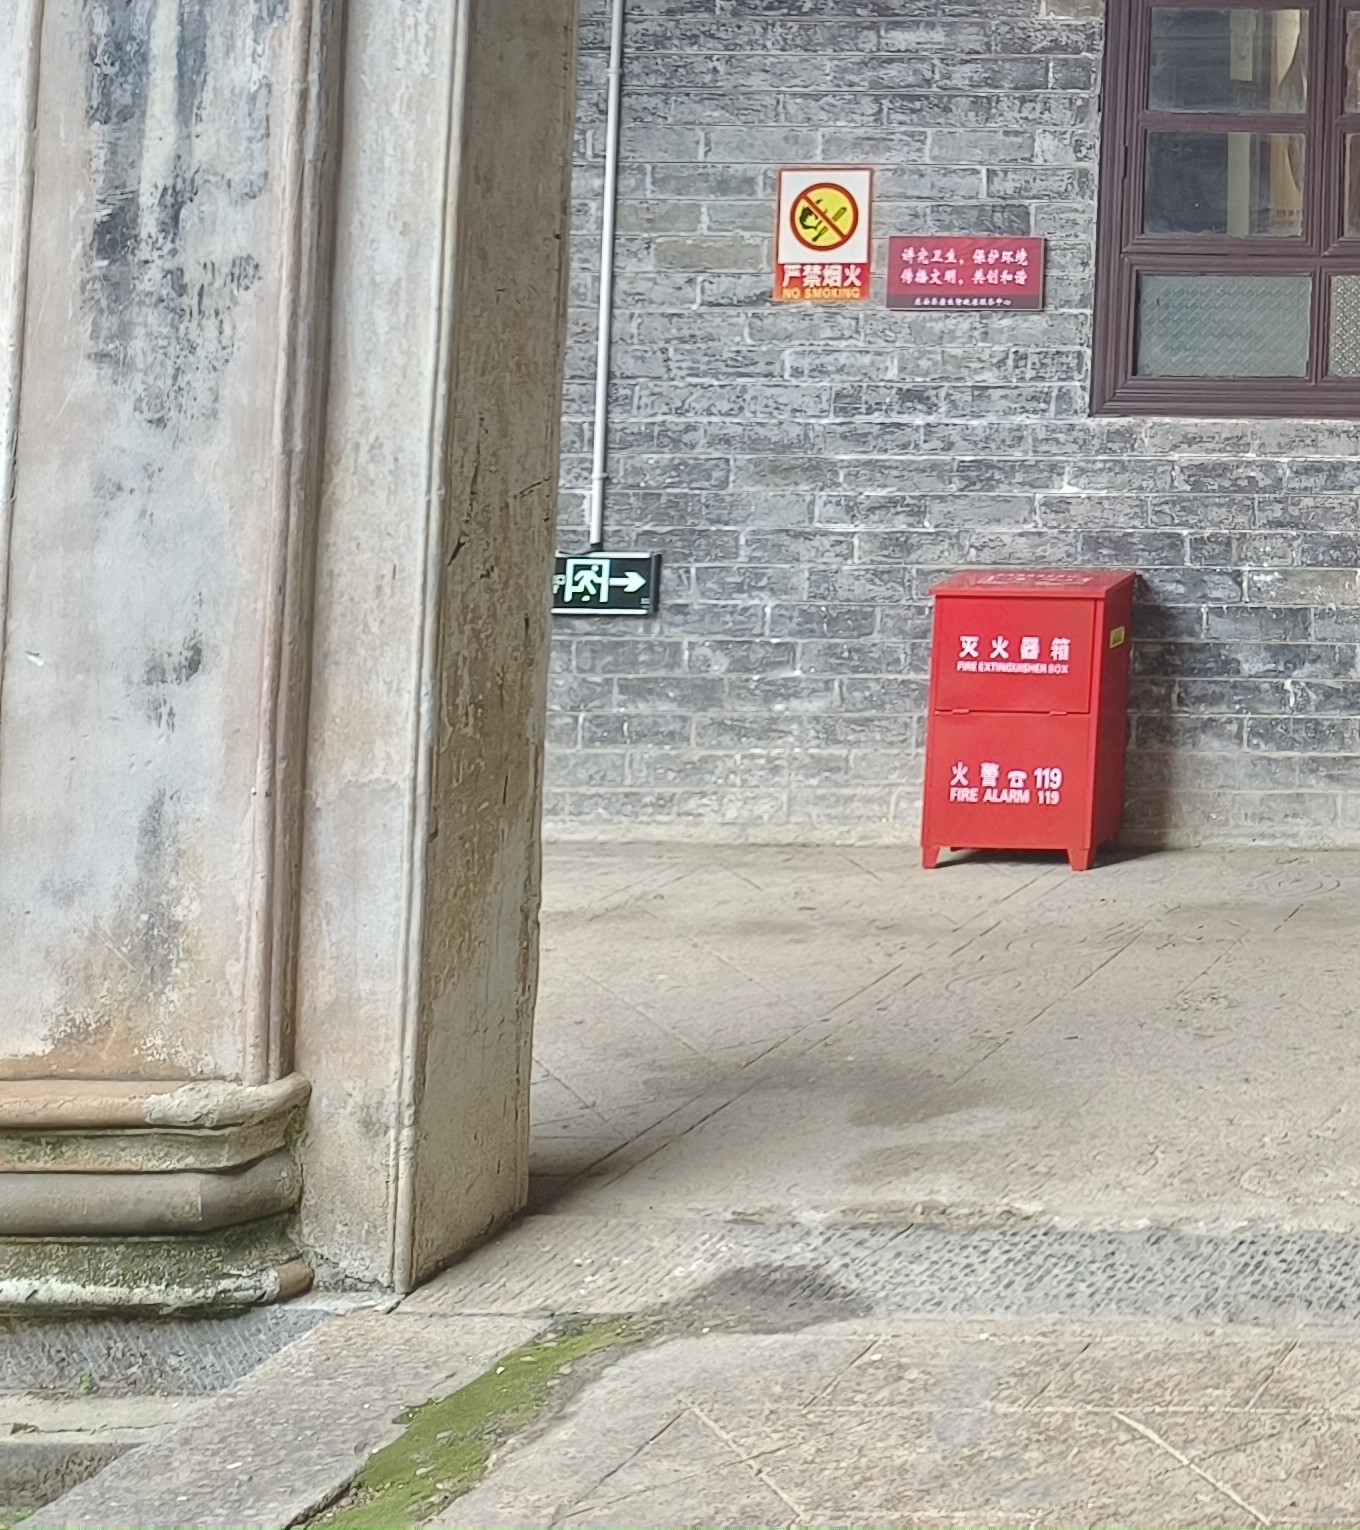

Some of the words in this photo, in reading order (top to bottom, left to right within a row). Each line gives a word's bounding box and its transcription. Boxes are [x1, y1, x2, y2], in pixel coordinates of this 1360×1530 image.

[782, 264, 862, 288] 严禁烟火
[782, 287, 801, 300] NO
[804, 287, 862, 300] SMOKING
[958, 635, 1071, 661] 灭火器箱
[956, 660, 978, 672] FIRE
[1048, 663, 1069, 674] BOX
[950, 761, 1000, 787] 火警
[1034, 767, 1063, 790] 119
[949, 787, 978, 803] FIRE
[983, 788, 1030, 804] ALARM
[1037, 790, 1060, 805] 119
